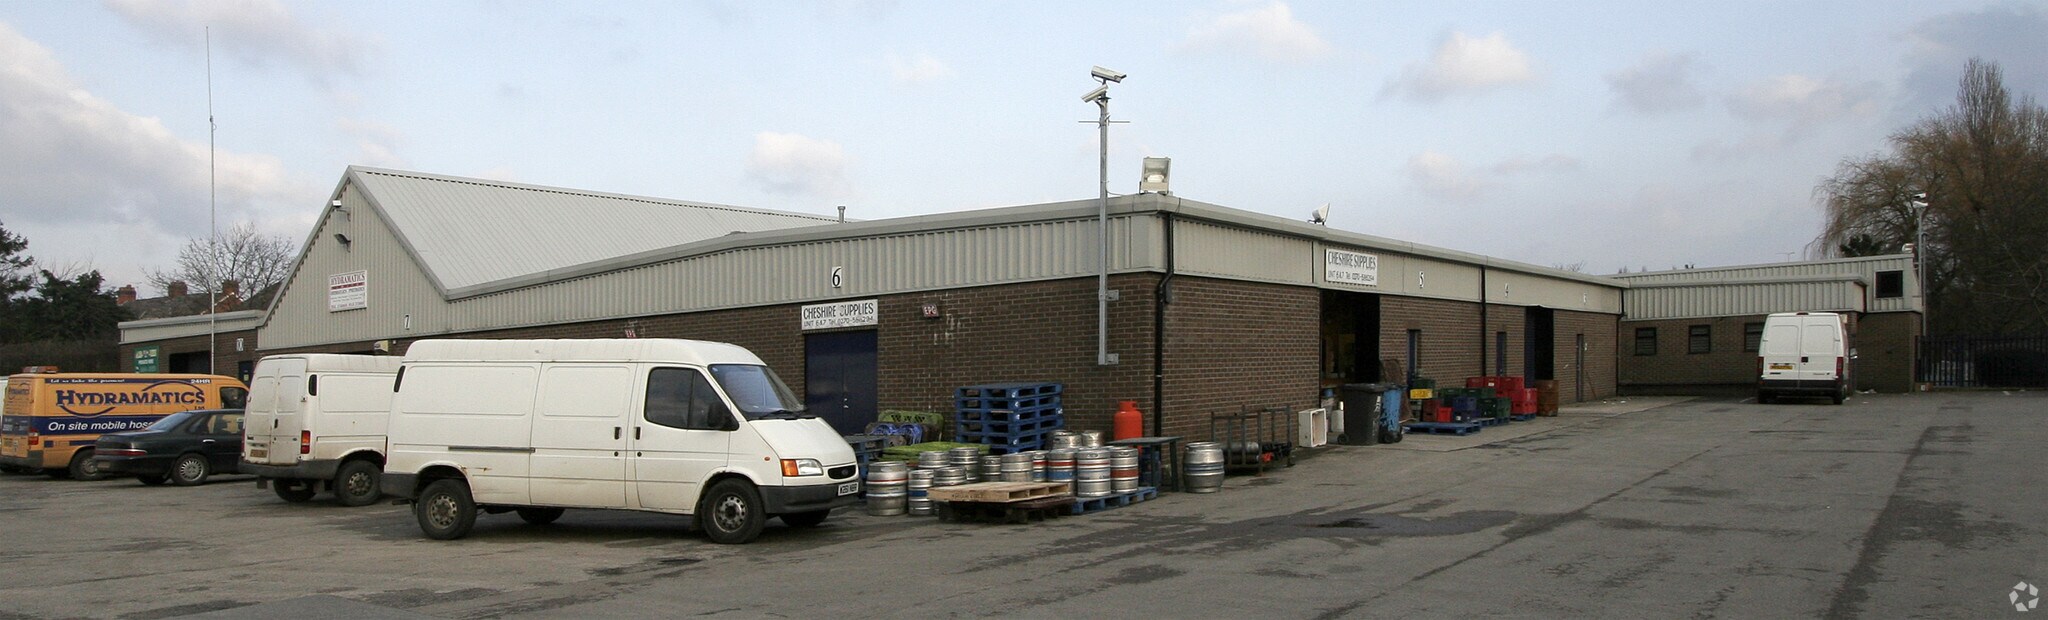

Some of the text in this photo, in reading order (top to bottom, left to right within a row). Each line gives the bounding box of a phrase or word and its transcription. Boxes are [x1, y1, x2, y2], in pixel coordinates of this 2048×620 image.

[1328, 251, 1376, 269] CHESHIRE SUPPLIES
[331, 273, 365, 285] HYDRAMATICS
[832, 267, 842, 287] 6
[803, 302, 874, 320] CHESHIRE SUPPLIES
[48, 421, 66, 431] On
[67, 421, 88, 431] site
[90, 421, 126, 430] mobile
